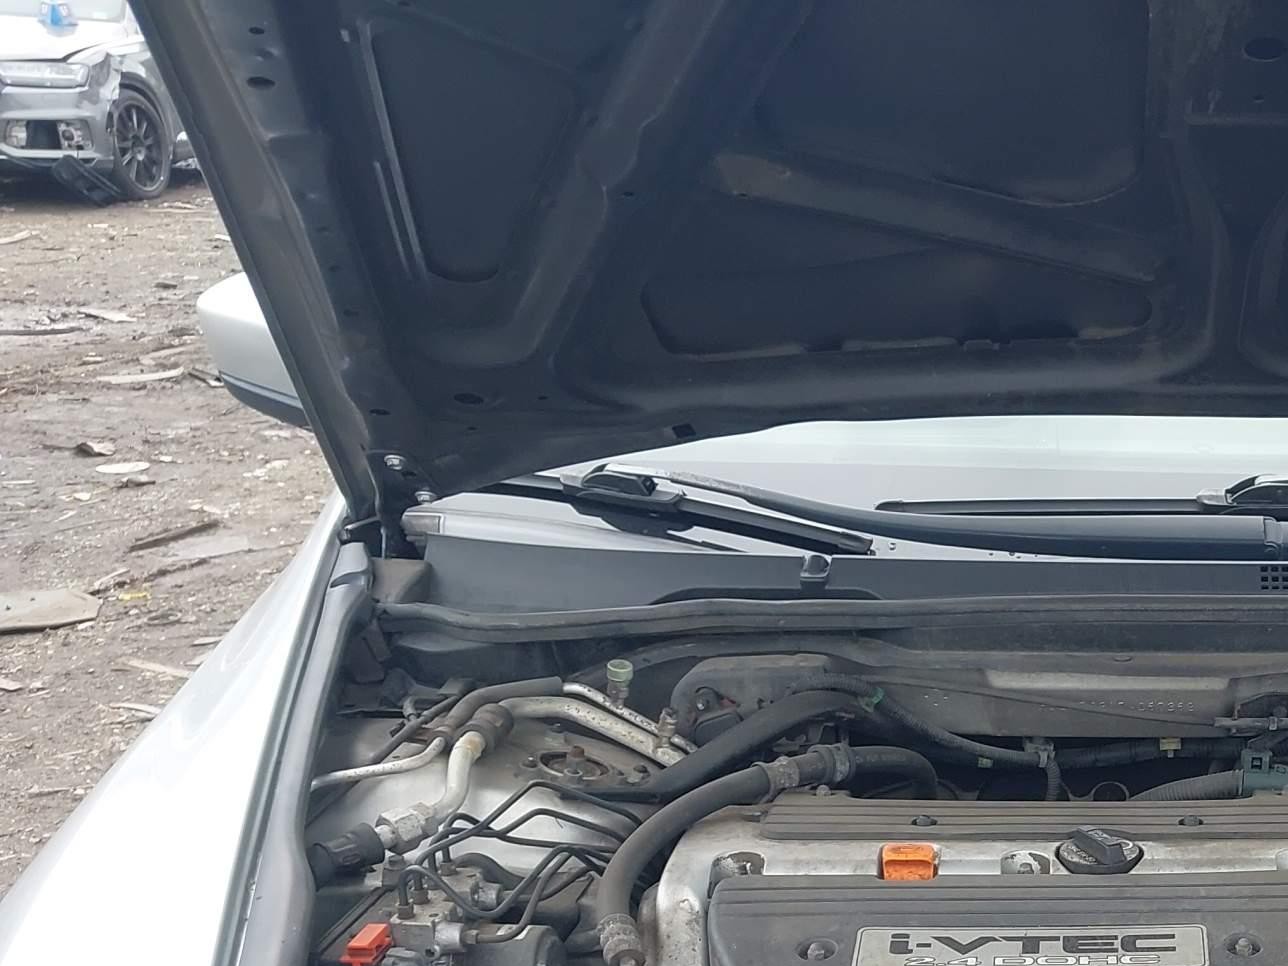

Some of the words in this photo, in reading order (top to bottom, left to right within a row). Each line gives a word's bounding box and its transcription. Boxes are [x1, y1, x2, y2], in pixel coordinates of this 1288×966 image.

[889, 933, 1177, 955] i-VTEC
[904, 956, 980, 966] 2.4
[993, 954, 1161, 966] DOHC
